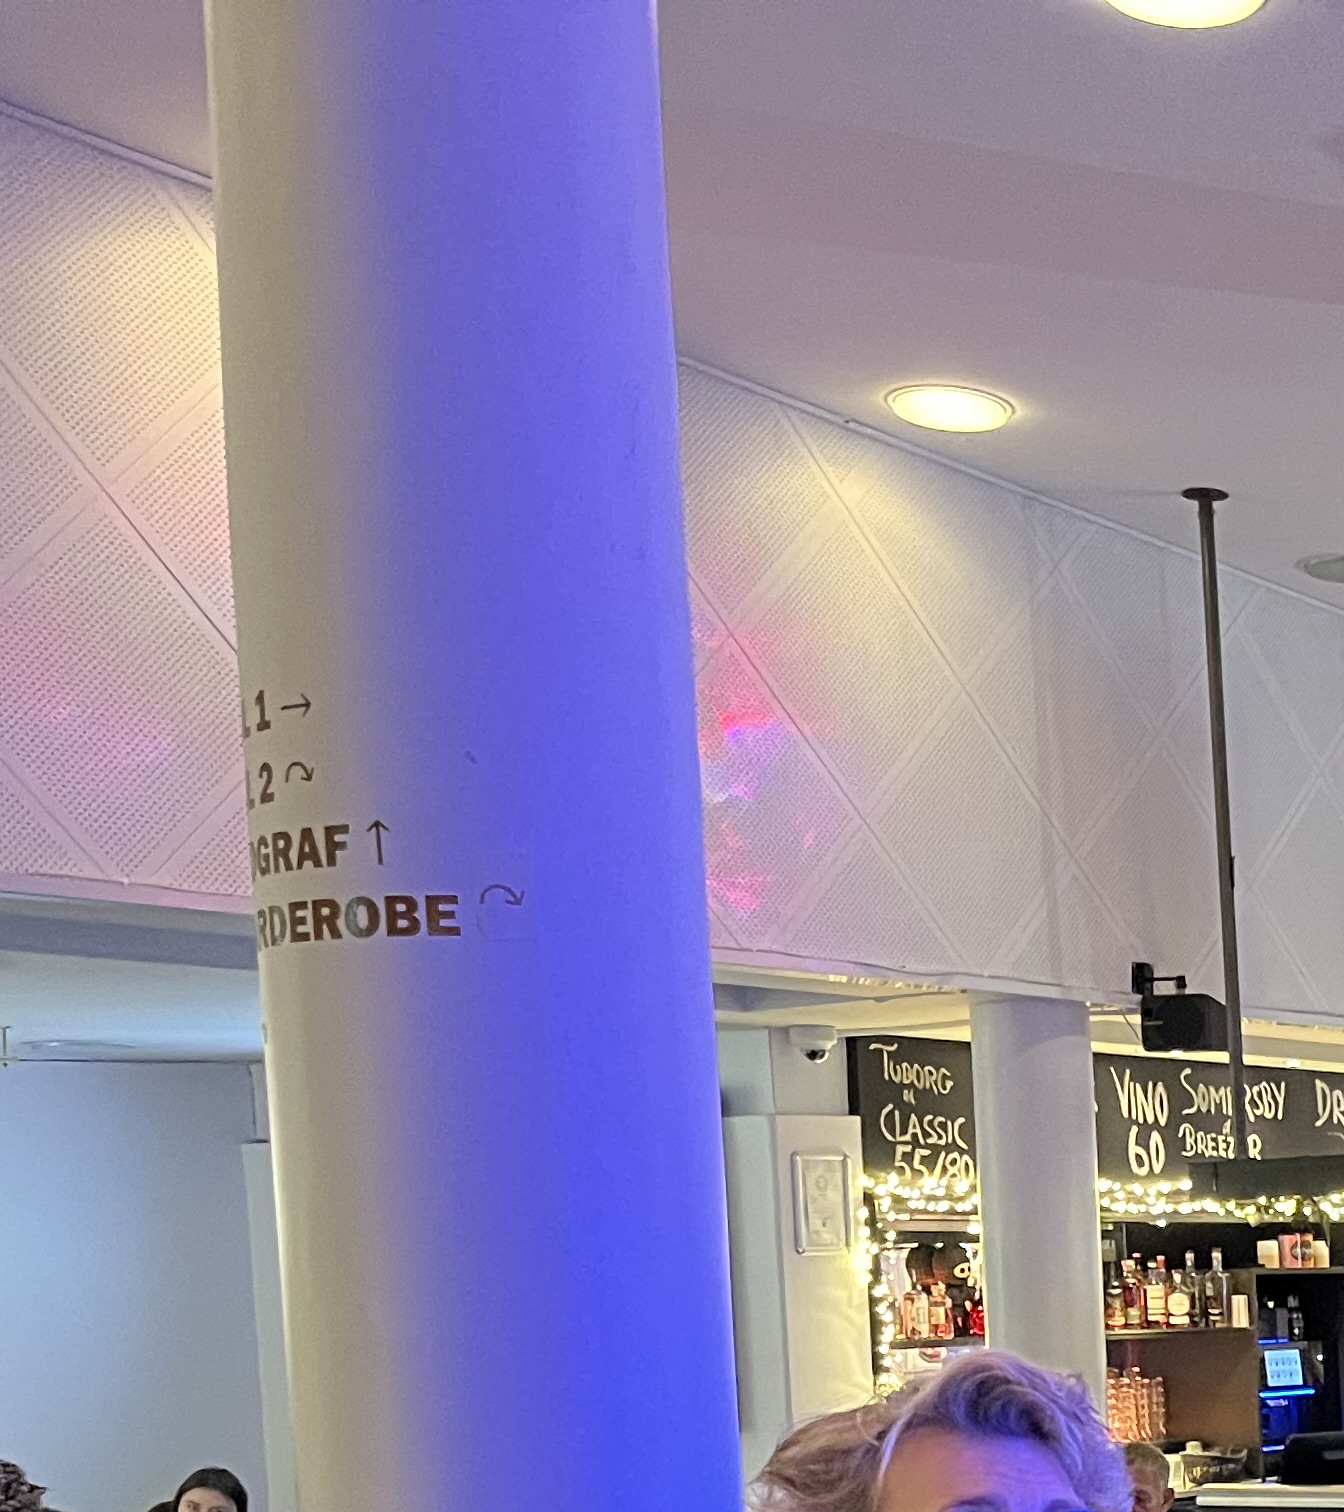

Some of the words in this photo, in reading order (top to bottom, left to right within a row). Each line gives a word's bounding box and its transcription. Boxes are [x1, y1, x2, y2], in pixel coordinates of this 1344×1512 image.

[1109, 1066, 1169, 1127] VINO
[880, 1104, 969, 1150] CLASSIC
[1128, 1125, 1165, 1176] 60
[1178, 1123, 1262, 1161] BREEZR
